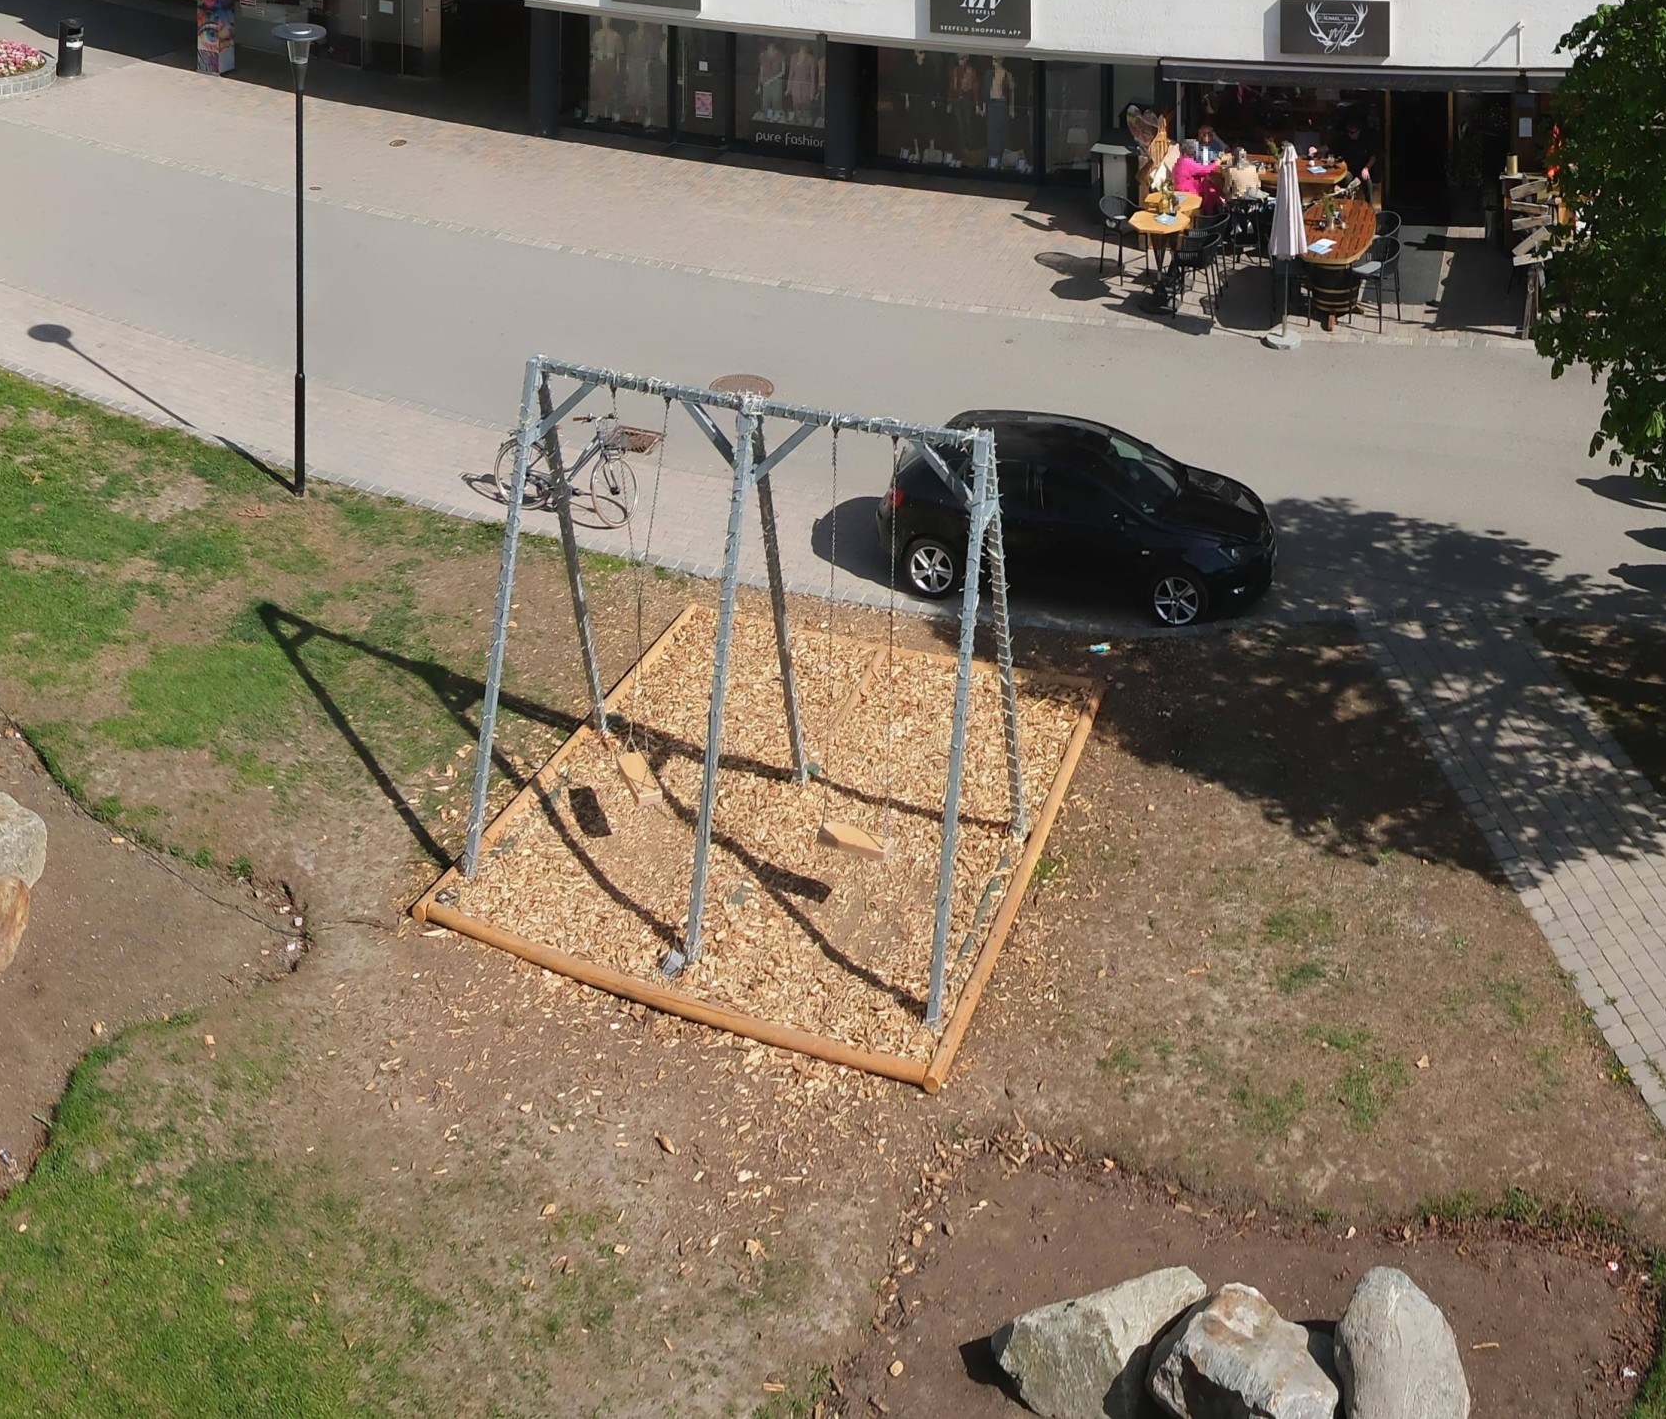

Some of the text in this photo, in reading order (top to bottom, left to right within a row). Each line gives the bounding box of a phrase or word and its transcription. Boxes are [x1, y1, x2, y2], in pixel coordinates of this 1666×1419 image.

[967, 8, 995, 16] SEEFELD
[971, 27, 1006, 35] SHOPPING
[756, 132, 781, 143] pure
